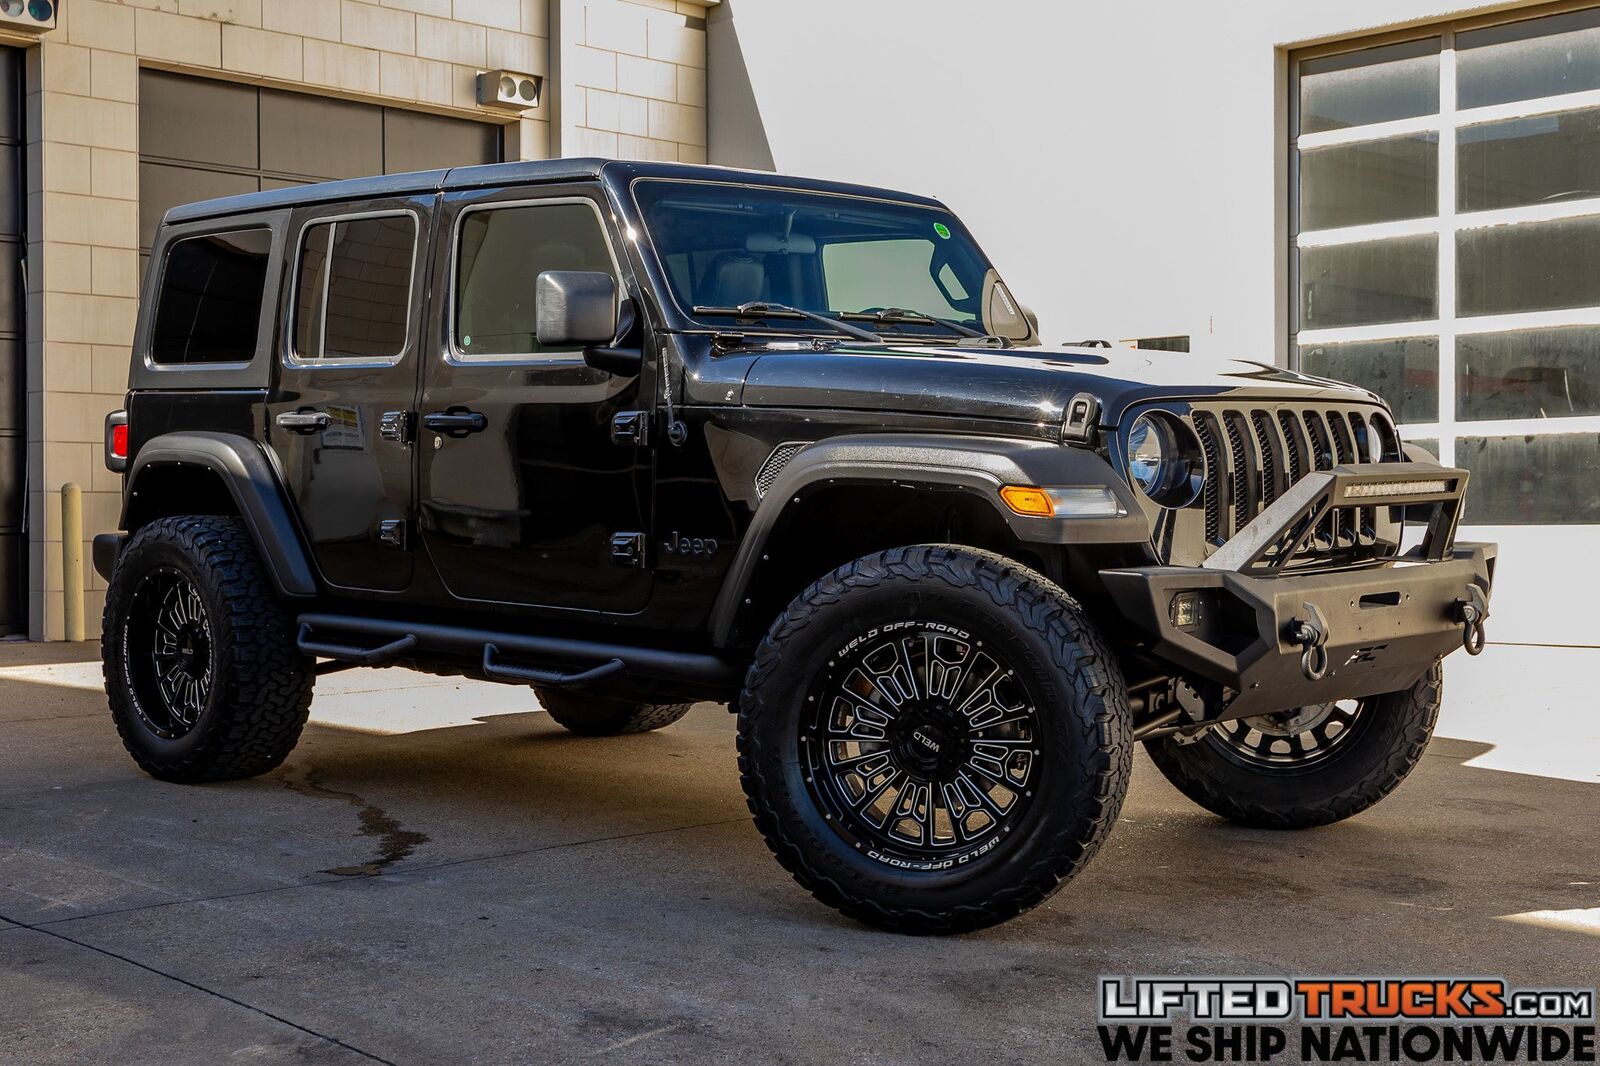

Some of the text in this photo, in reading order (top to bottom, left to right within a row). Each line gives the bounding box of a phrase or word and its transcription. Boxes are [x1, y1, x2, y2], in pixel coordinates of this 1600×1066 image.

[664, 531, 718, 560] Jeep
[838, 629, 878, 657] WELD
[883, 621, 970, 640] OFF-ROAD
[913, 731, 940, 753] WELD
[867, 836, 1000, 870] WELD OFF-ROAD
